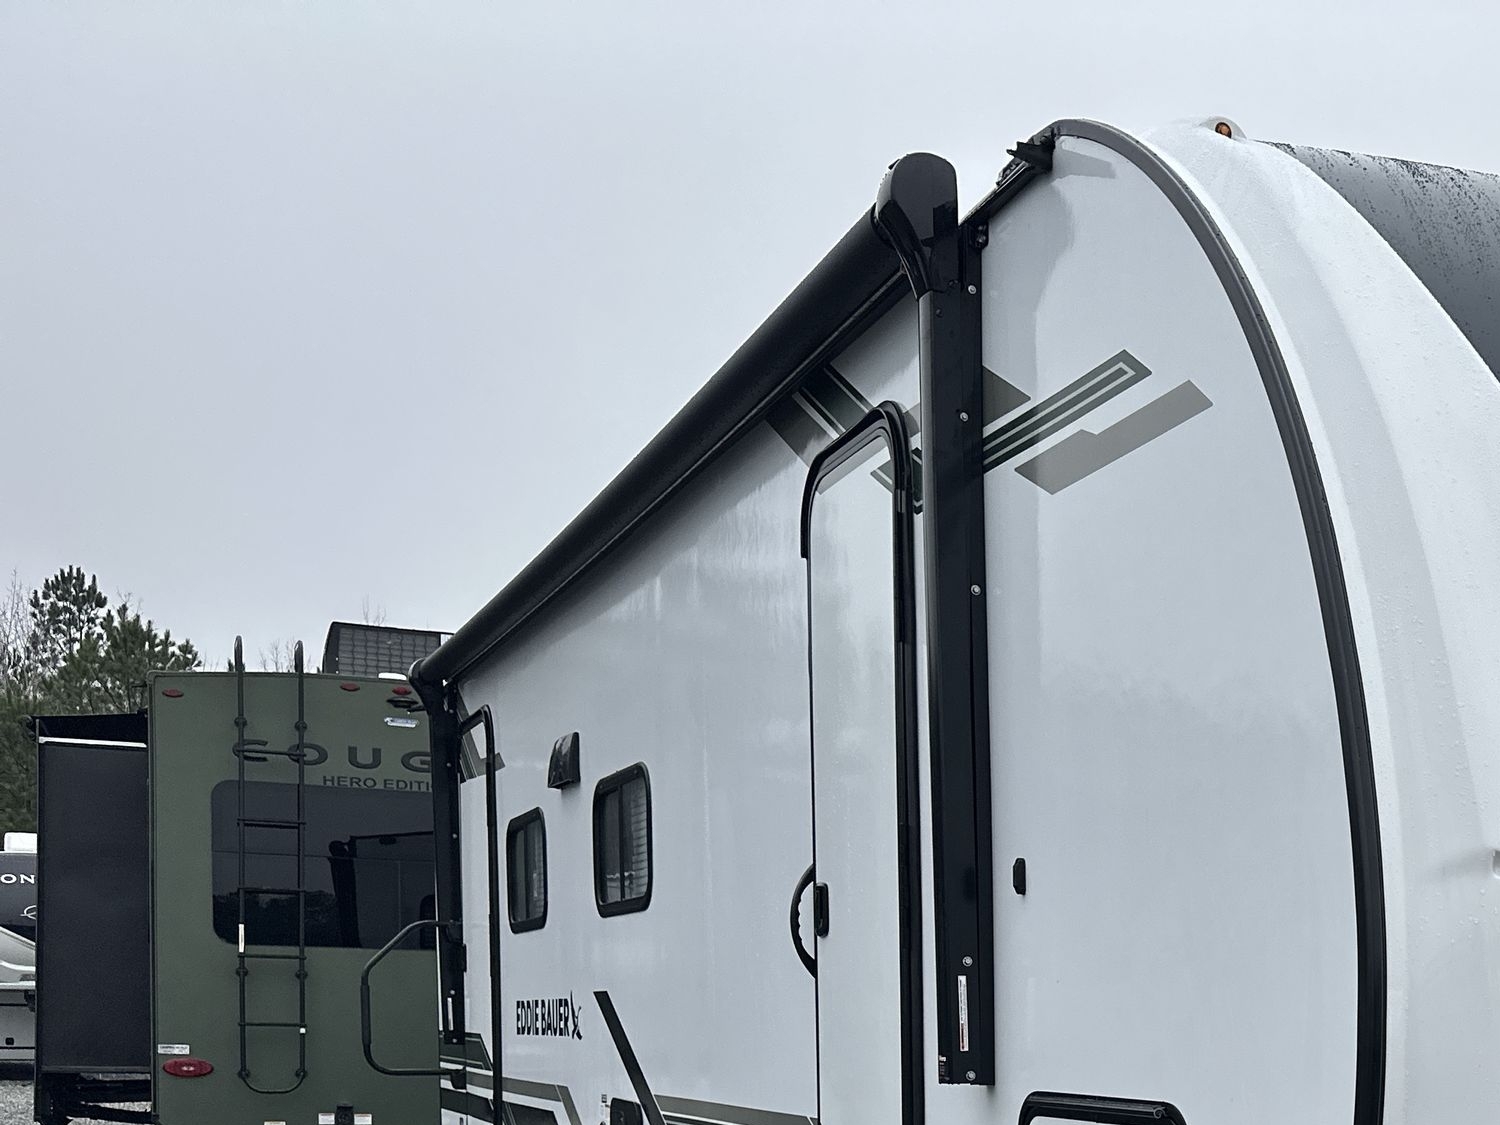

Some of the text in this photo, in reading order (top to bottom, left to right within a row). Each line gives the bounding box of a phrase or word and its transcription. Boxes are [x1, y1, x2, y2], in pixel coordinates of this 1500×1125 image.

[322, 775, 432, 792] HERO EDITI
[516, 998, 569, 1036] EDDIE BAUER
